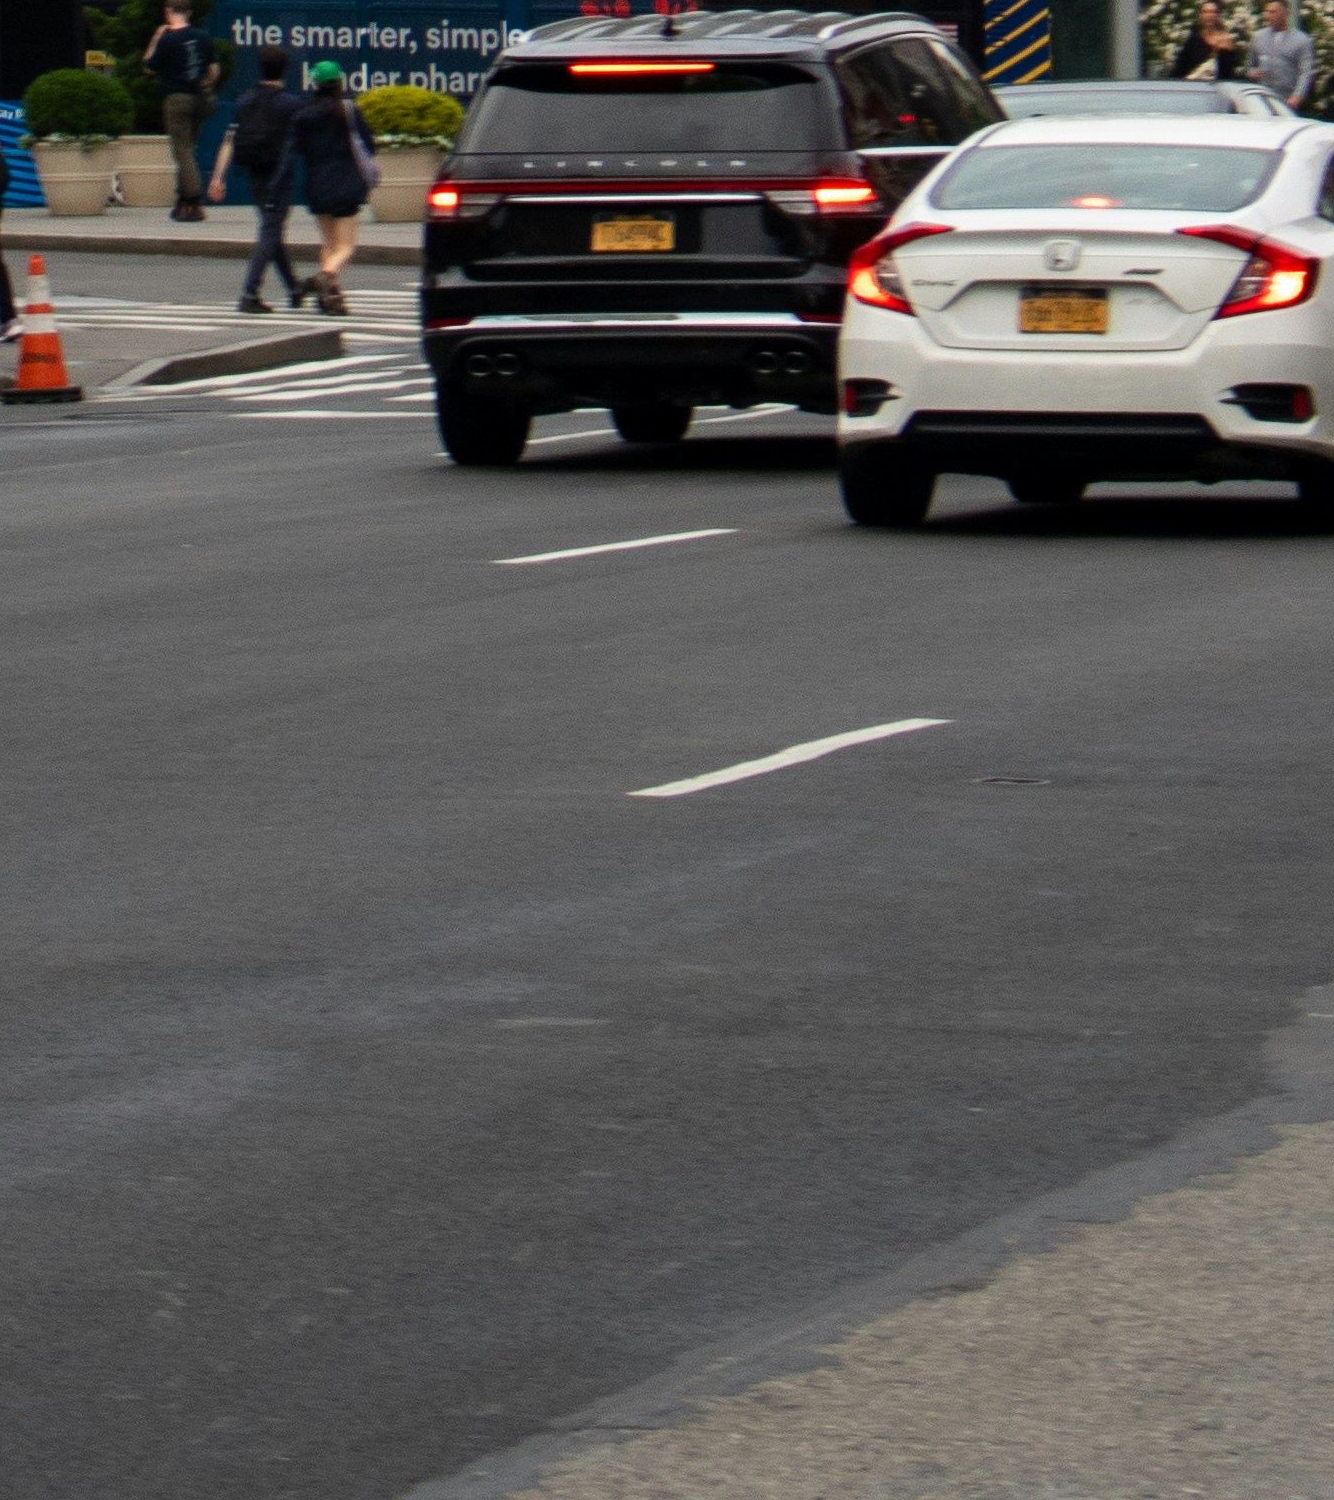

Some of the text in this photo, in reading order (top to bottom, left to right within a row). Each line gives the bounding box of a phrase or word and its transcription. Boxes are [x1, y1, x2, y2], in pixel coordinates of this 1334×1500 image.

[232, 16, 525, 56] the smarter, simple
[301, 60, 402, 91] kder
